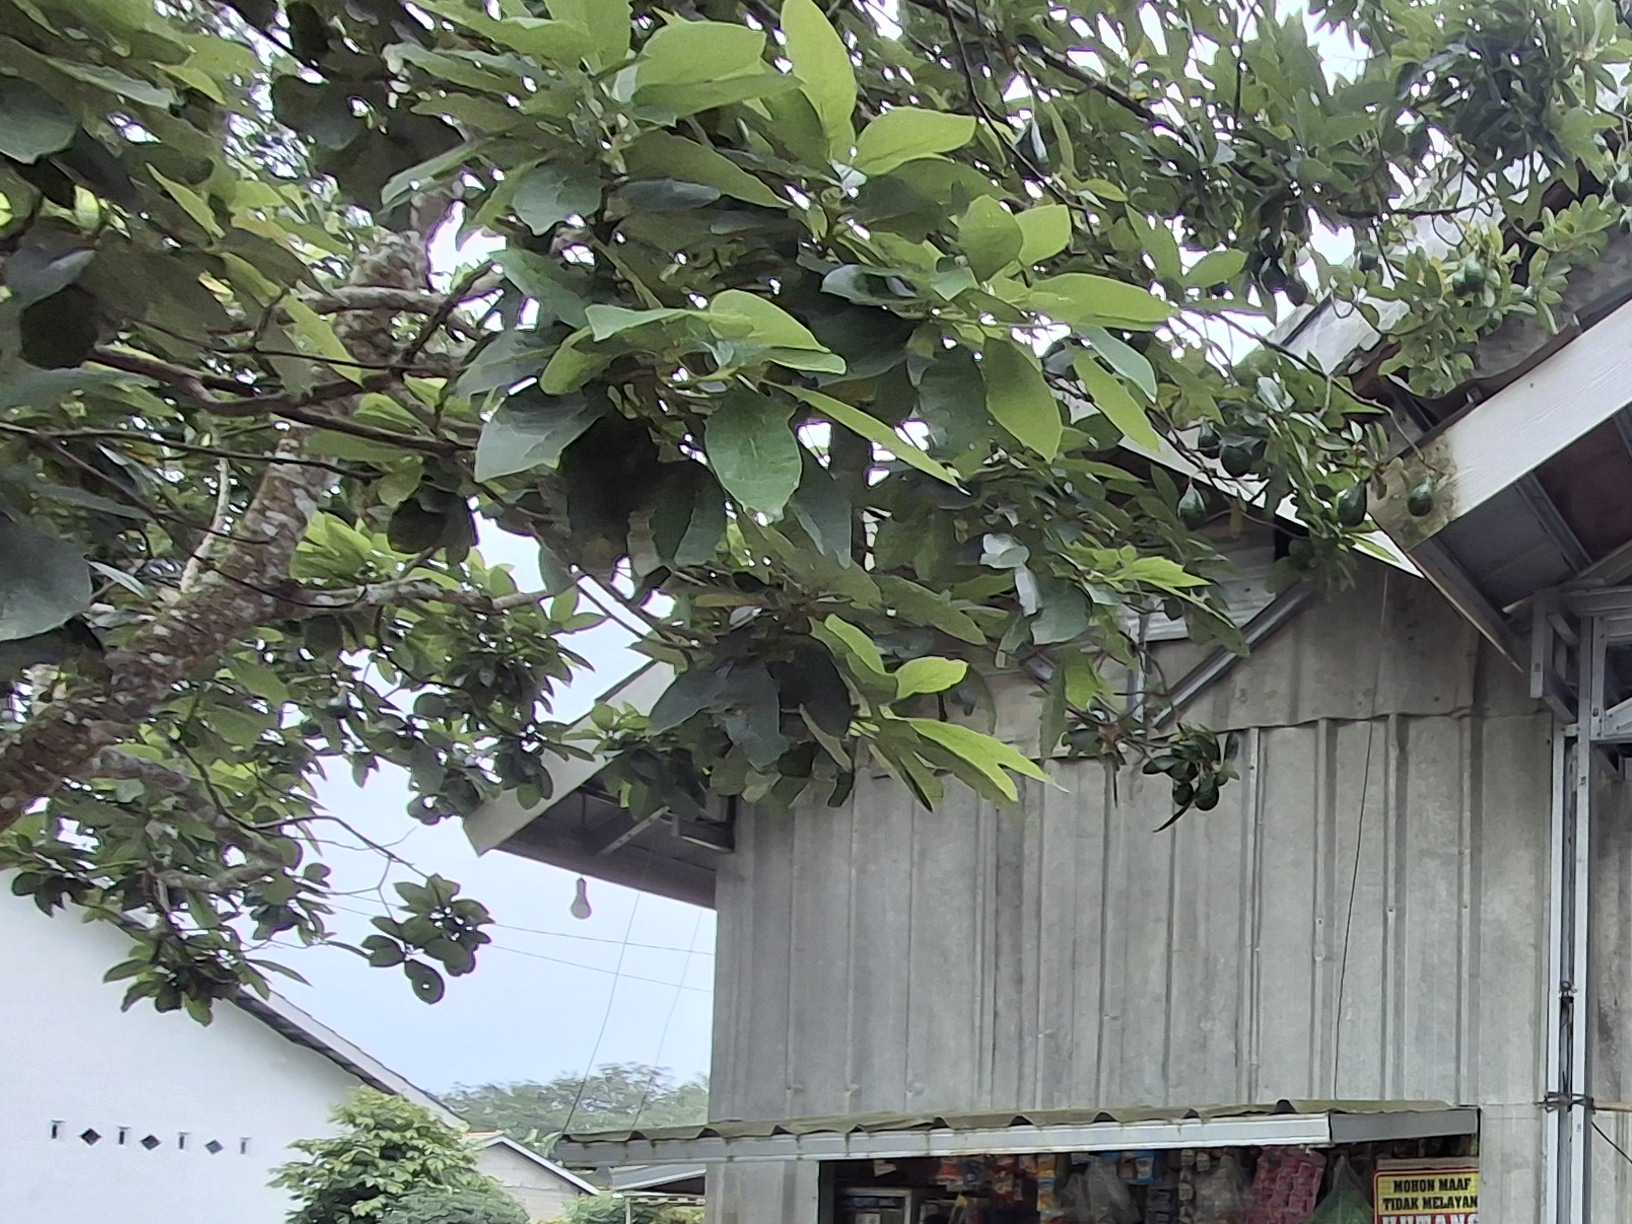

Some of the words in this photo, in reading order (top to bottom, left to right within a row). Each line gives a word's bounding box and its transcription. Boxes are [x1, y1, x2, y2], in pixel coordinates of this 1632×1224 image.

[1394, 1180, 1435, 1193] MOHON
[1438, 1178, 1472, 1191] MAAF
[1383, 1198, 1419, 1211] TIDAK
